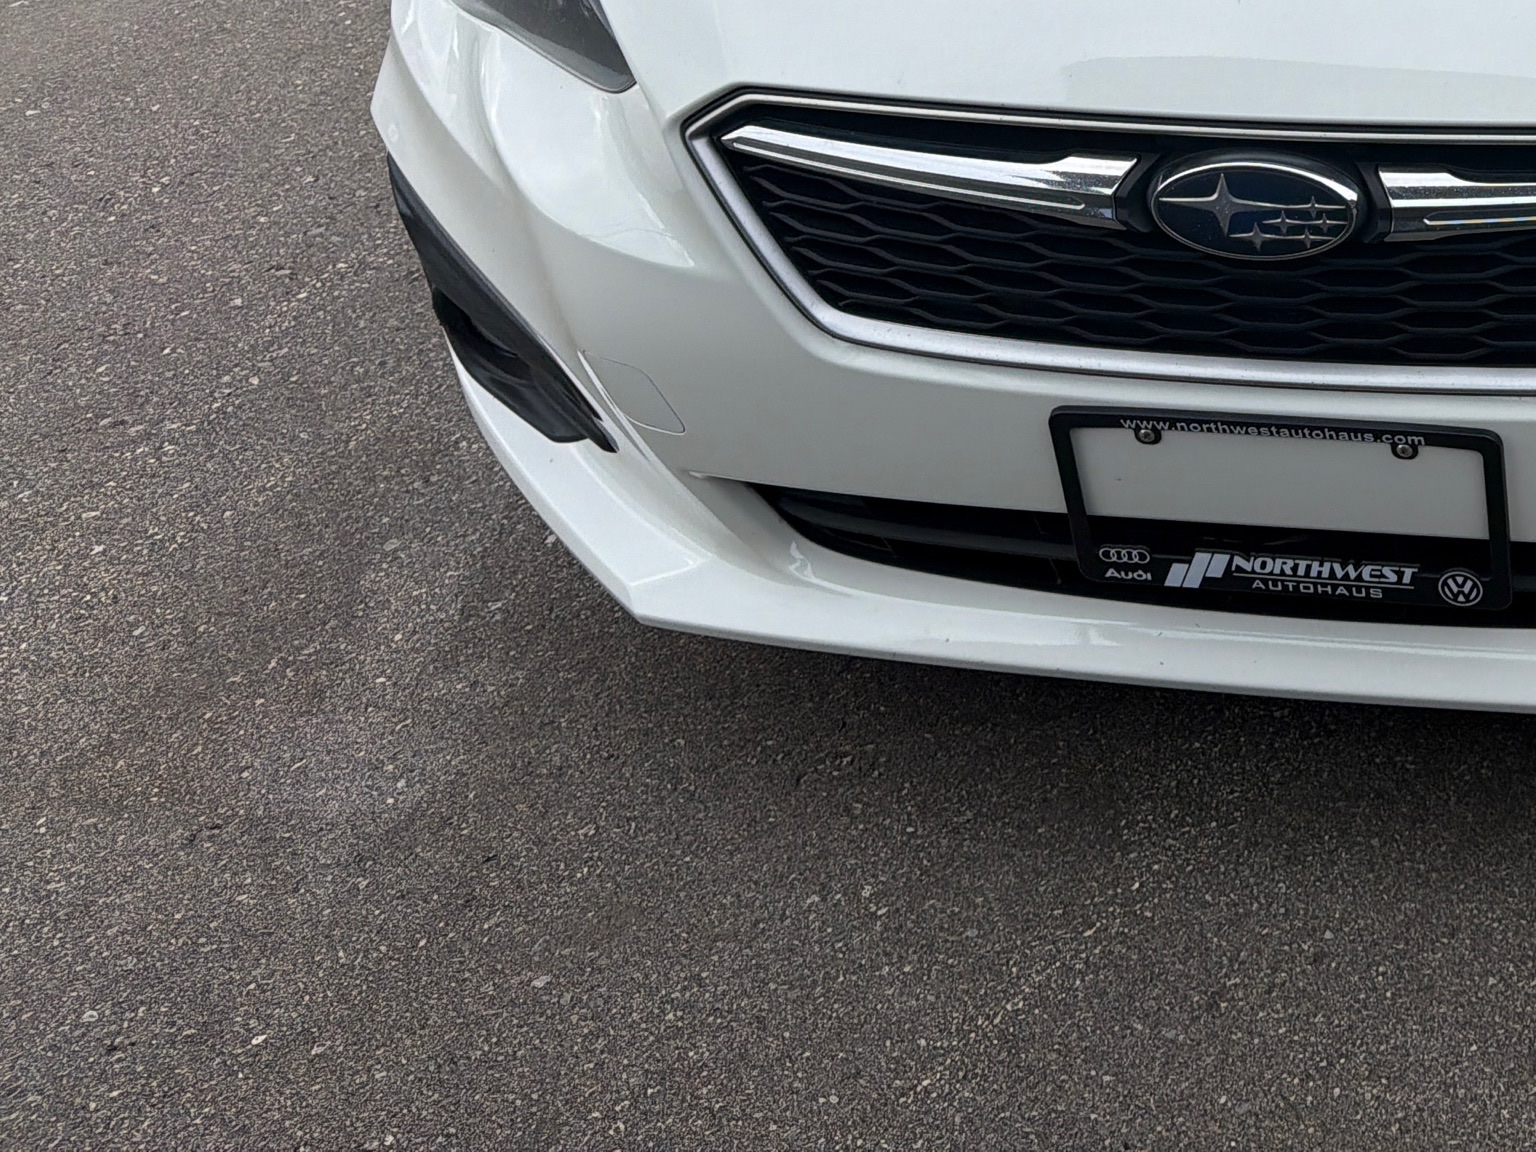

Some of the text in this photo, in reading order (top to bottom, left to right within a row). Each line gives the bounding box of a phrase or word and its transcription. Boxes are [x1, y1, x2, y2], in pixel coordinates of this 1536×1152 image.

[1120, 419, 1426, 446] www.northwestautohaus.com
[1231, 554, 1419, 584] NORTHWEST
[1252, 579, 1383, 598] AUTOHAUS
